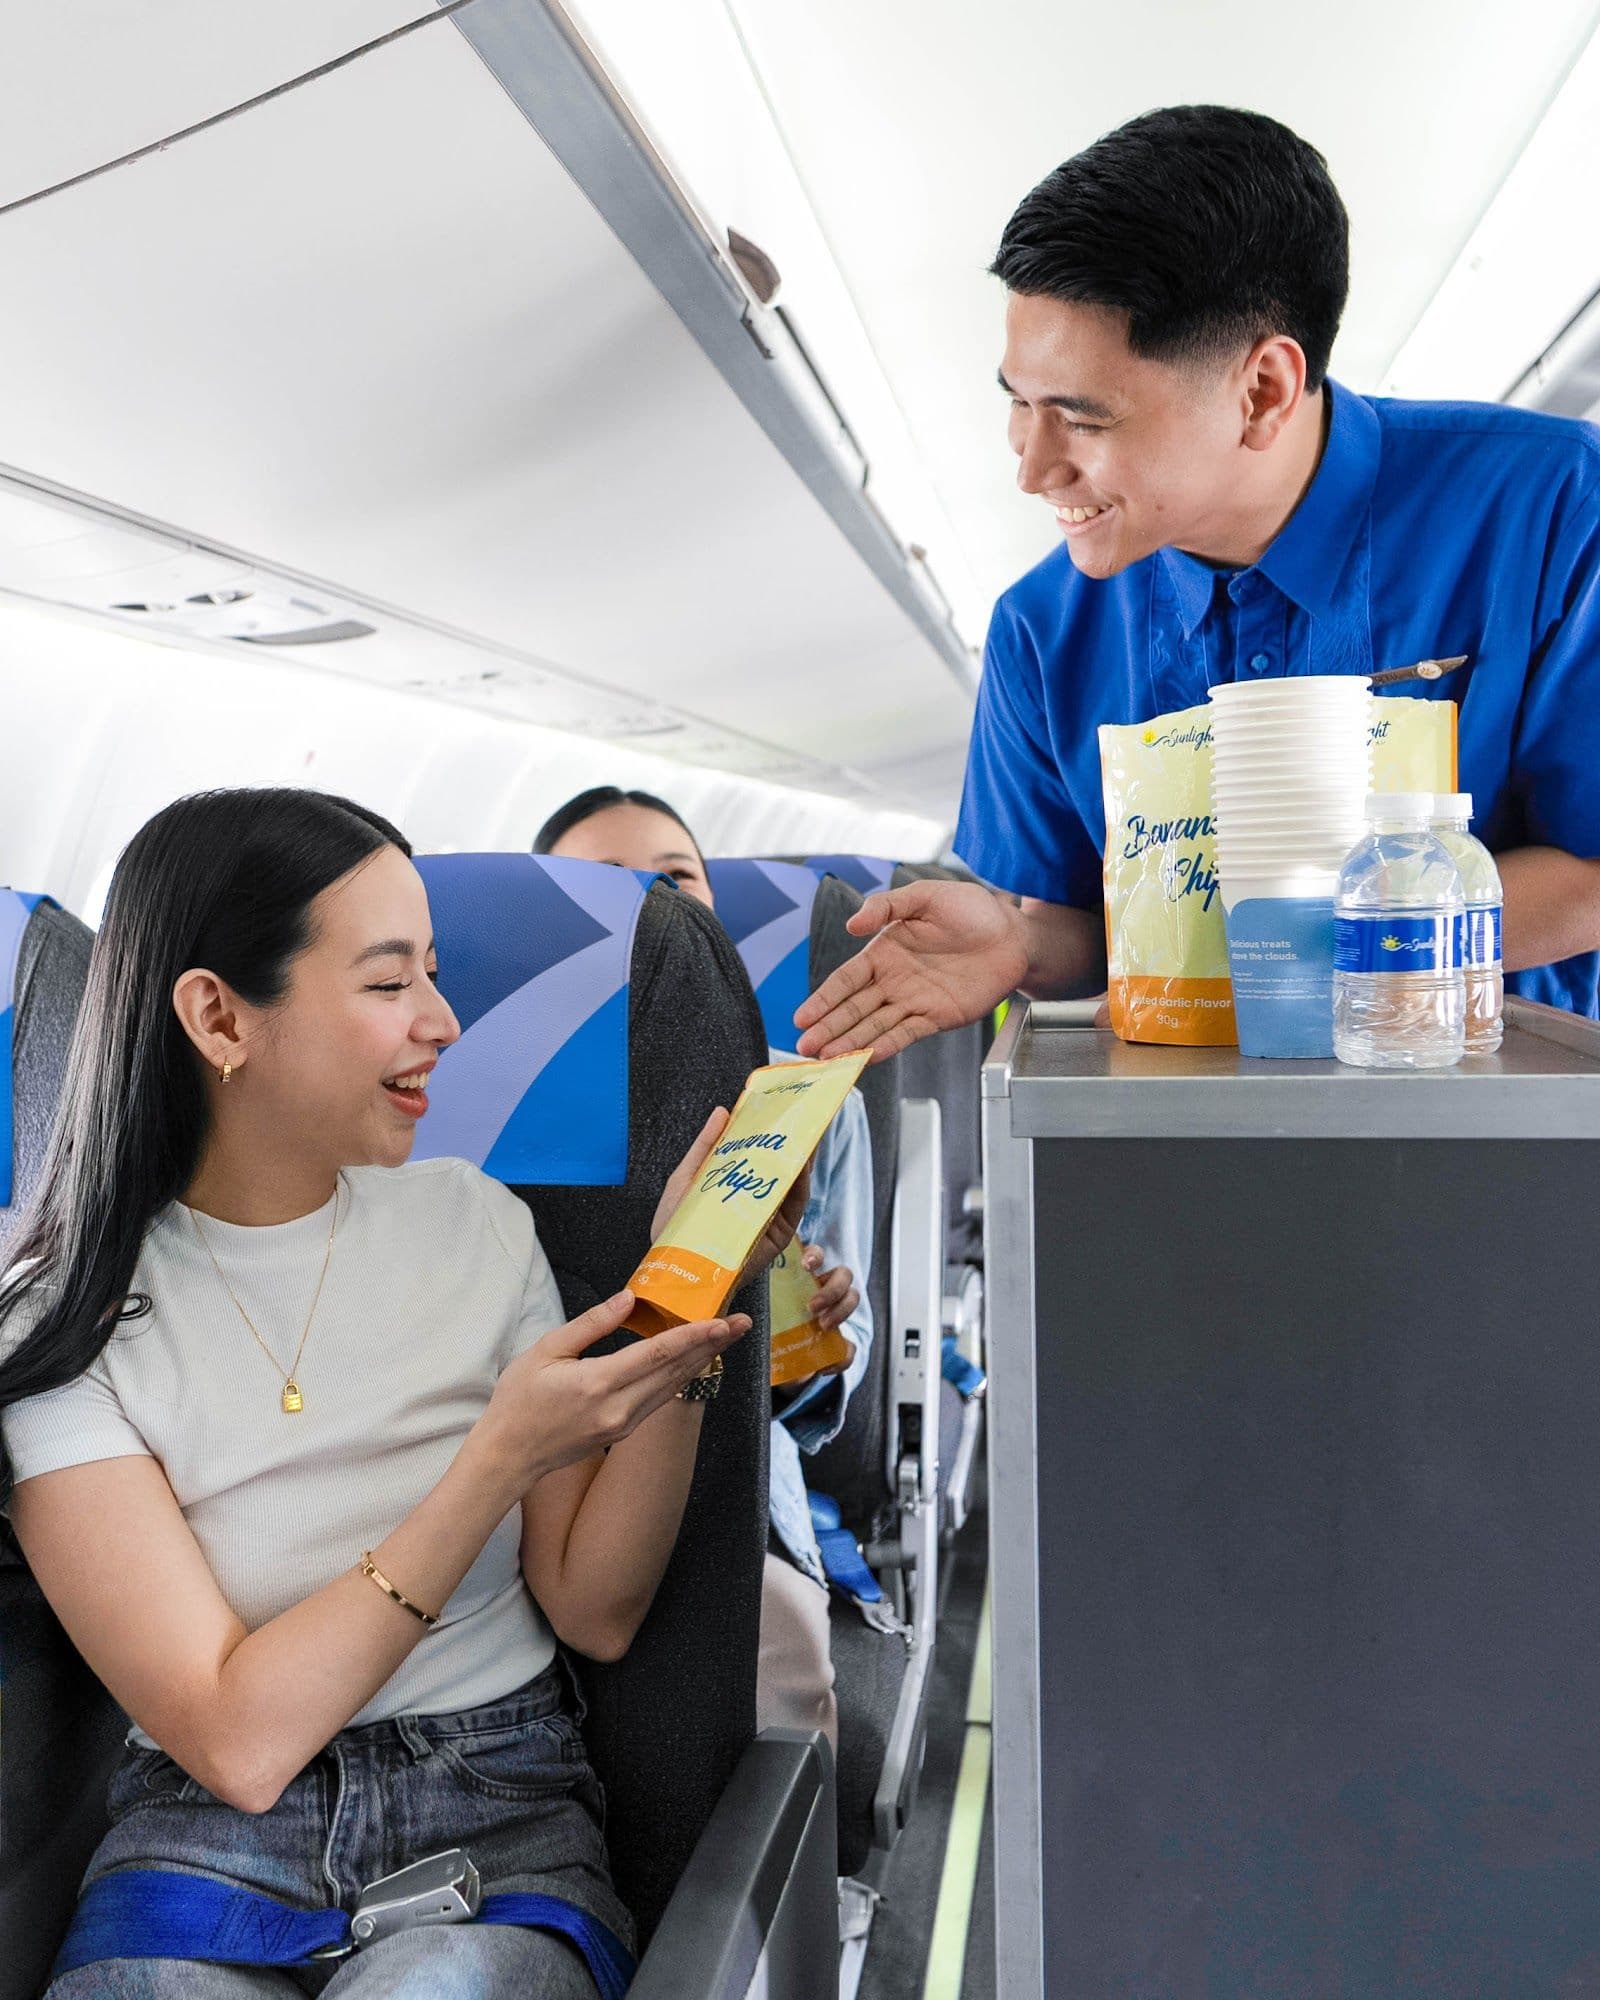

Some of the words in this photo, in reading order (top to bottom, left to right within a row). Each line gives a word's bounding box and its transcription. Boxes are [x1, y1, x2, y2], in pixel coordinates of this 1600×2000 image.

[1163, 725, 1215, 751] Sunligh
[1261, 940, 1292, 949] treats
[1249, 952, 1263, 961] the
[1158, 996, 1192, 1008] Garlic
[1194, 998, 1232, 1009] Flavor
[1156, 1013, 1179, 1029] 30g
[700, 1158, 779, 1203] Chips
[668, 1263, 701, 1284] Flavor
